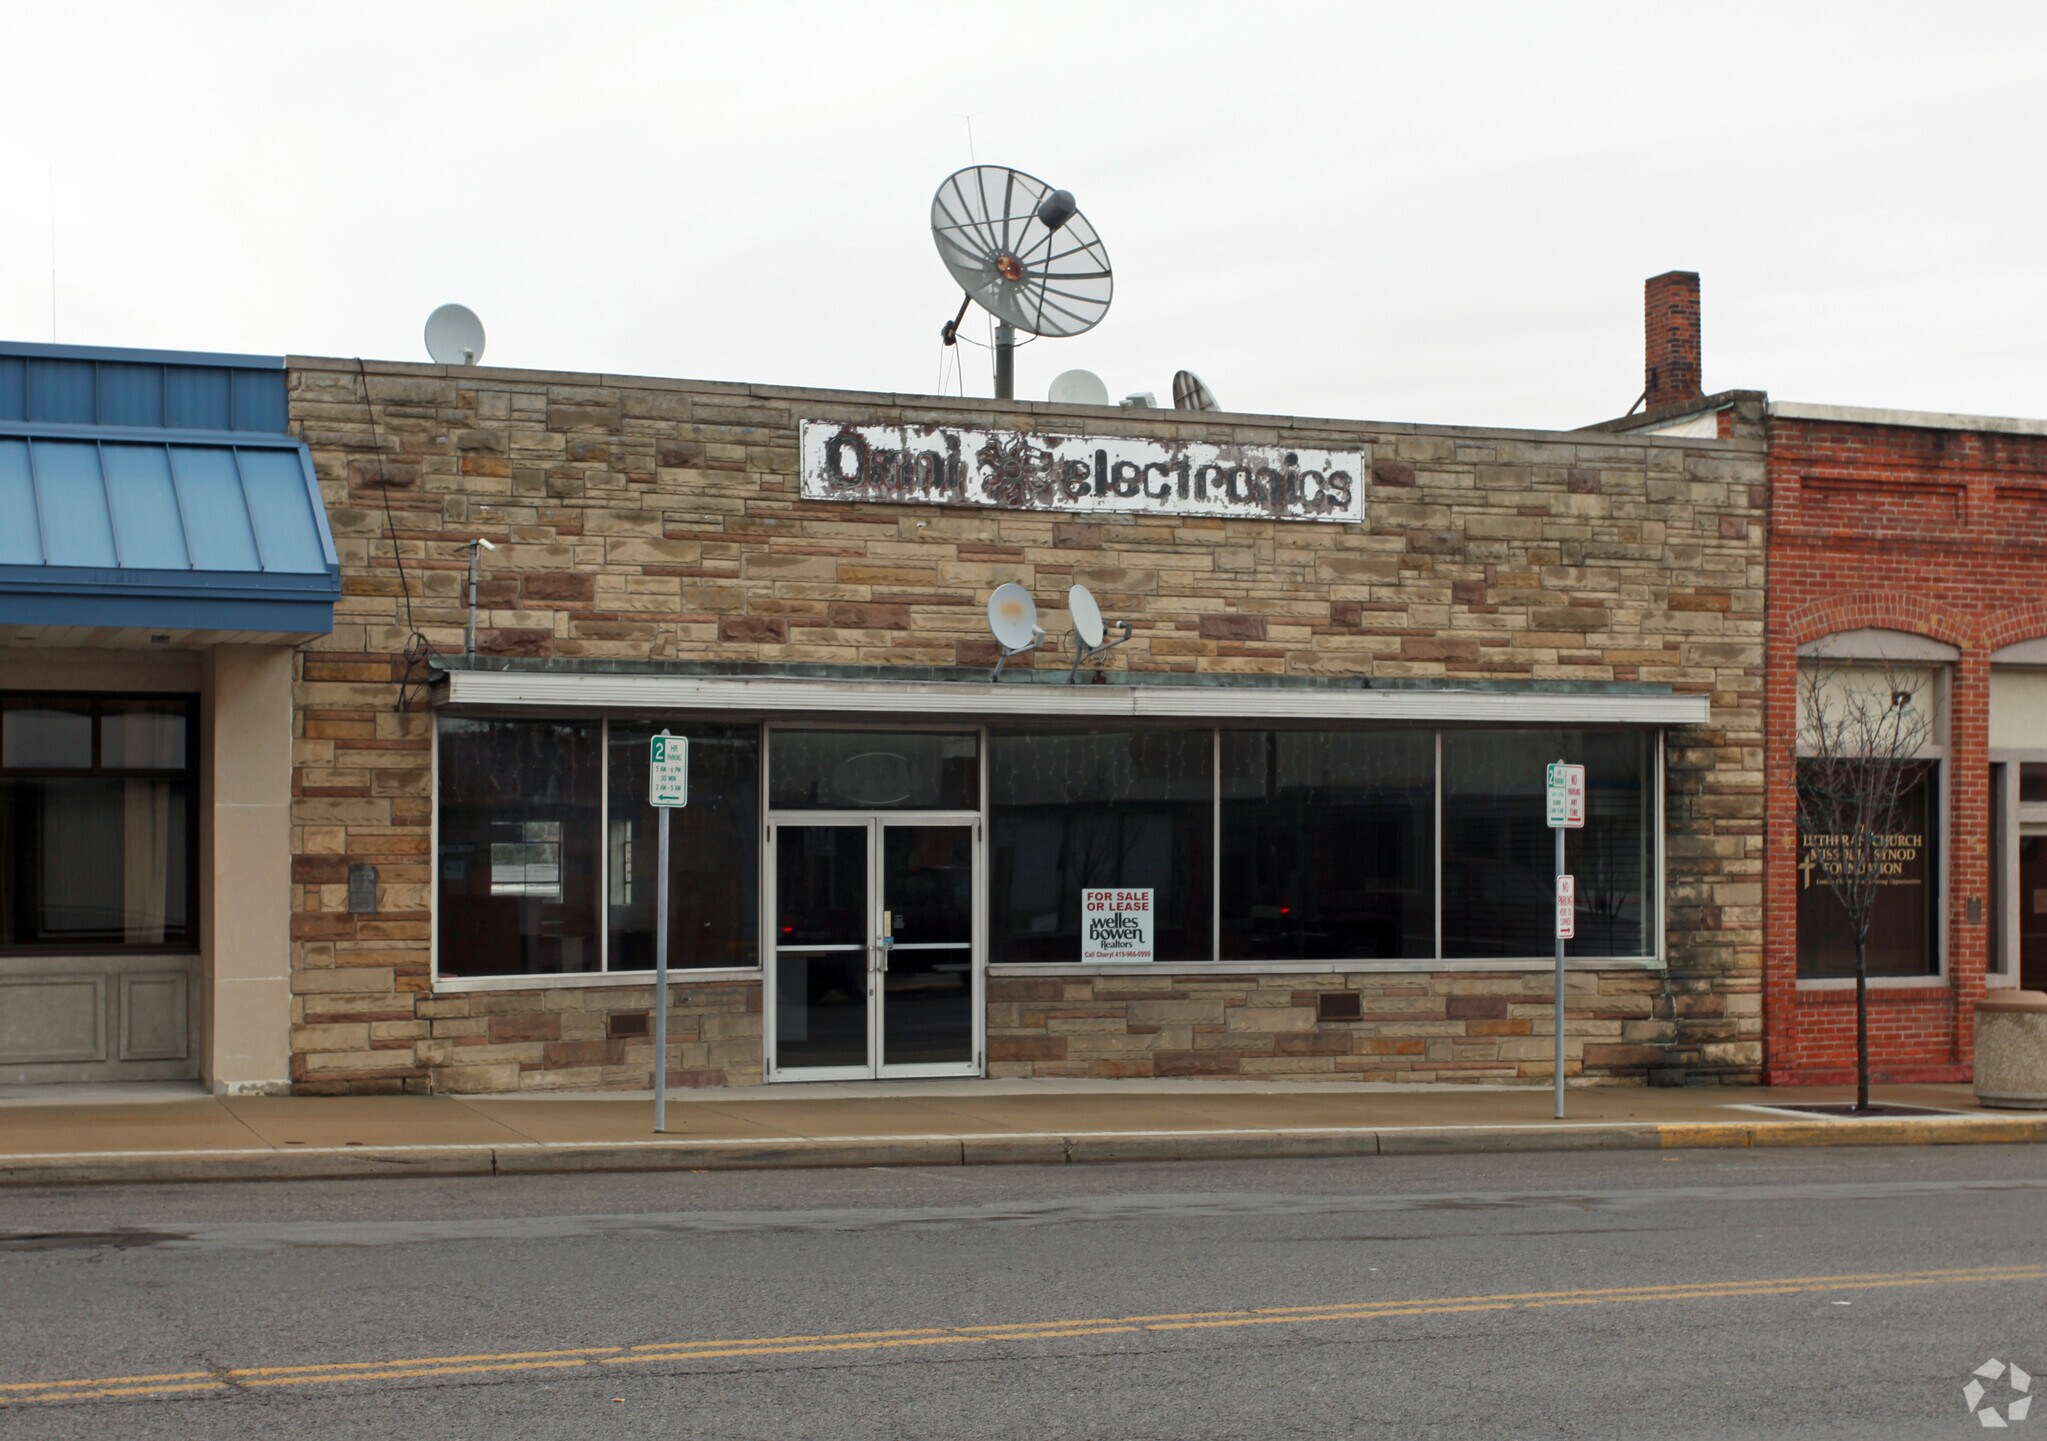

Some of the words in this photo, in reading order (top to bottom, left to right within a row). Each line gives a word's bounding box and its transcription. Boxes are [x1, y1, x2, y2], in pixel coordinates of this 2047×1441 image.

[824, 431, 964, 490] Omni
[1062, 448, 1353, 509] electronics
[656, 742, 664, 760] 2
[1549, 769, 1554, 785] 2
[1570, 774, 1577, 785] NO
[1567, 788, 1581, 796] PARKING
[1569, 808, 1579, 817] TIME
[1872, 834, 1922, 847] CHURCH
[1810, 848, 1868, 861] MISSOU
[1873, 848, 1916, 861] SYNOD
[1823, 862, 1903, 875] FONDION
[1562, 881, 1569, 893] NO
[1087, 892, 1112, 901] FOR
[1116, 892, 1149, 901] SALE
[1558, 896, 1573, 906] PARKING
[1087, 902, 1105, 911] OR
[1109, 902, 1149, 911] LEASE
[1091, 912, 1139, 929] welles
[1090, 924, 1146, 944] bowen
[1100, 939, 1133, 950] Realtors
[1096, 951, 1114, 959] Cheryl
